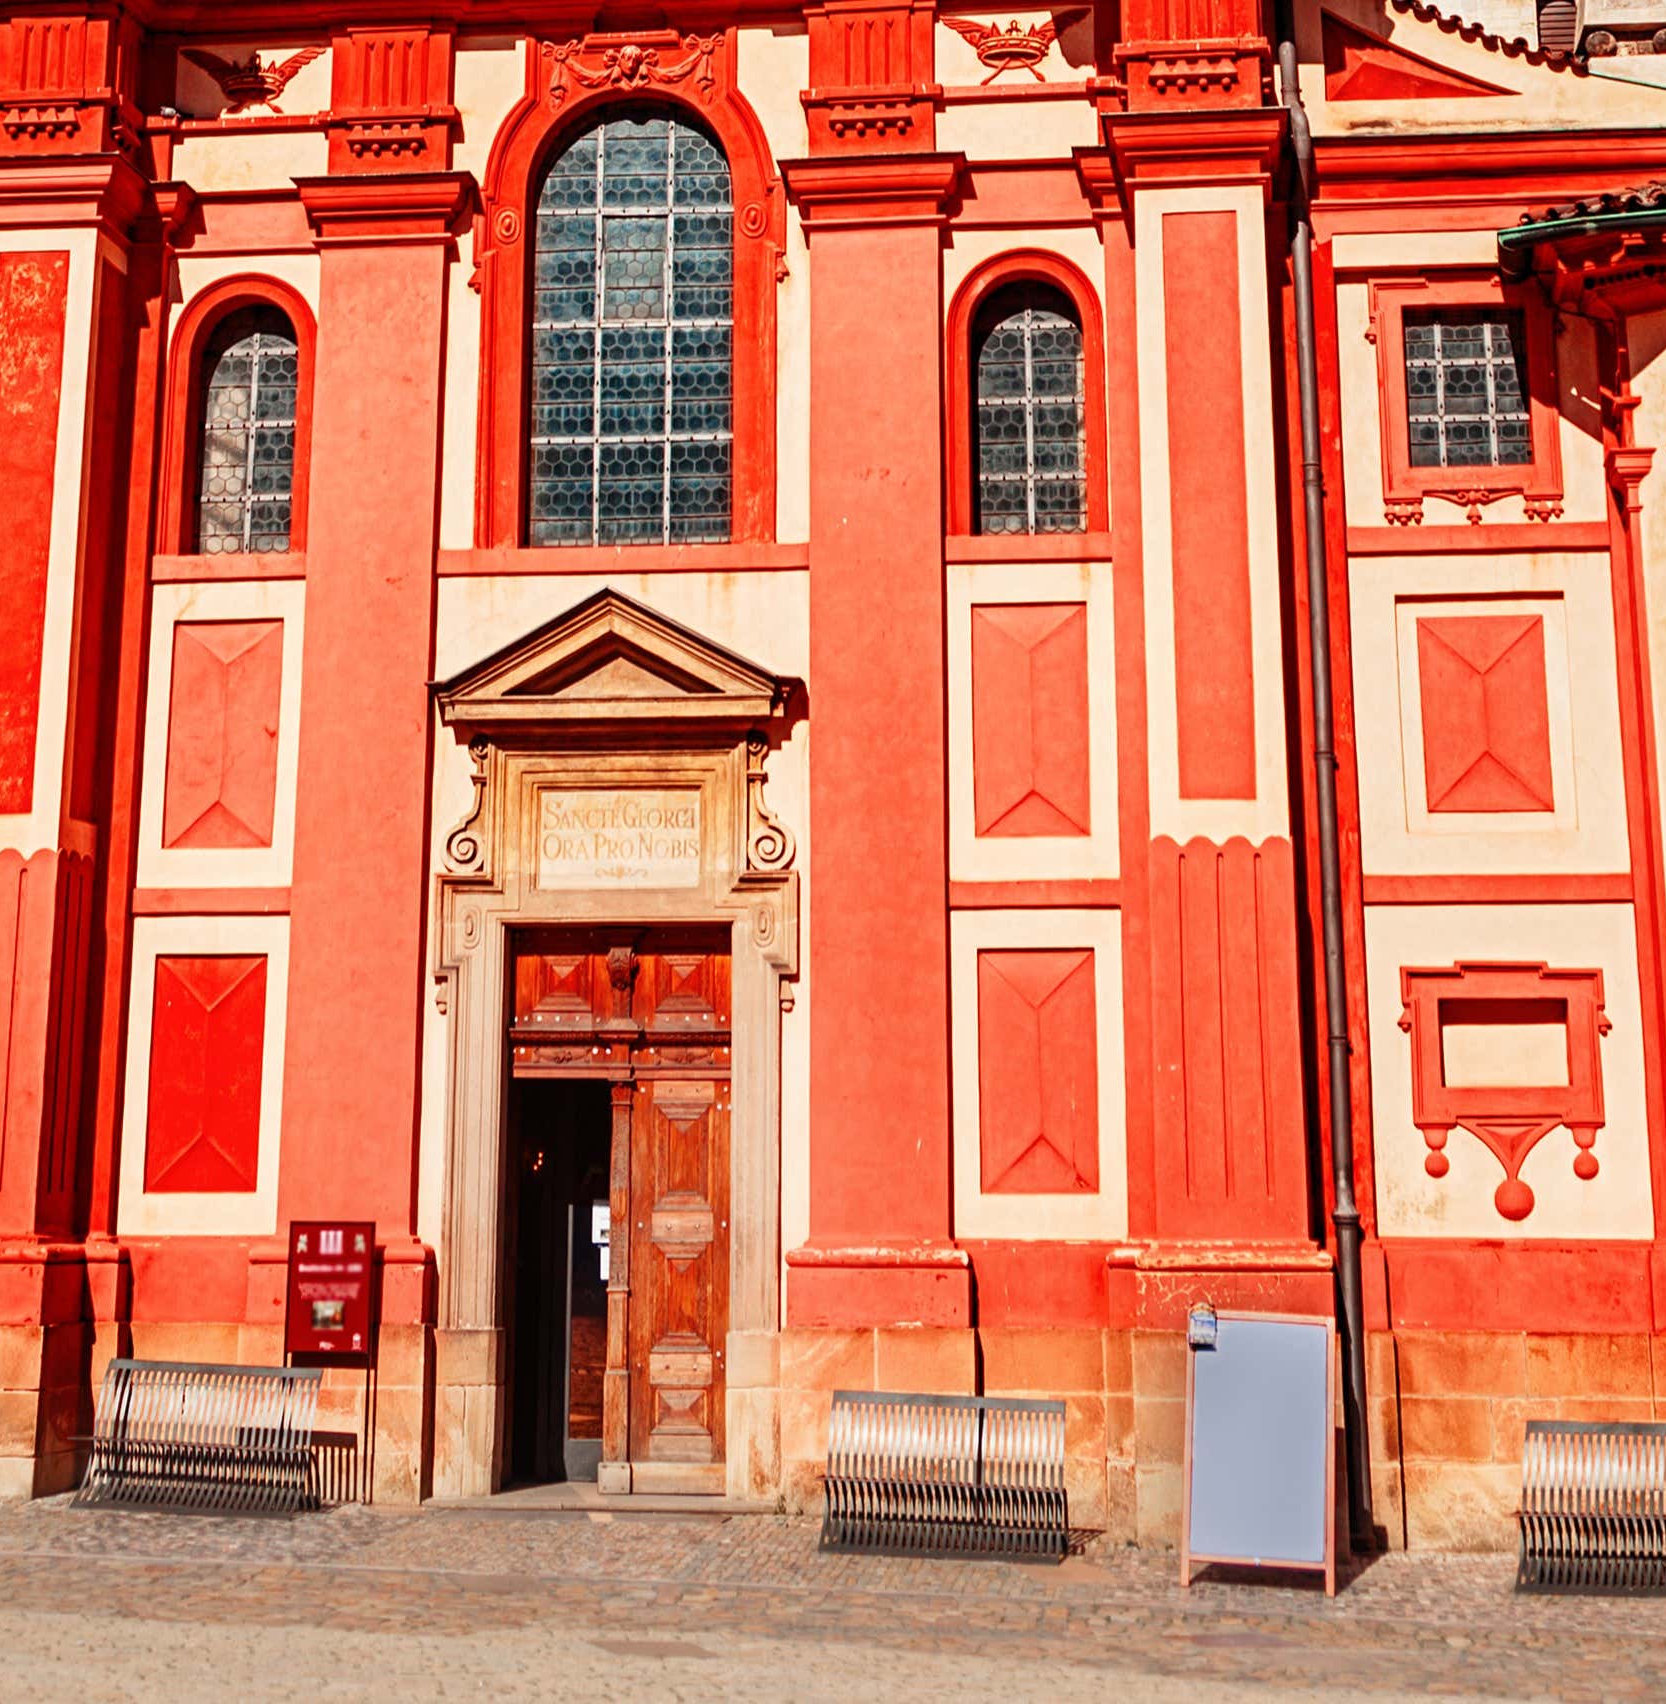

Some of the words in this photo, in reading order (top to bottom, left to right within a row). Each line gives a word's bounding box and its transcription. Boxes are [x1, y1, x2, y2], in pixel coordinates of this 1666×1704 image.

[543, 833, 589, 861] ORA
[593, 832, 634, 860] PRO
[637, 832, 699, 860] NOBIS
